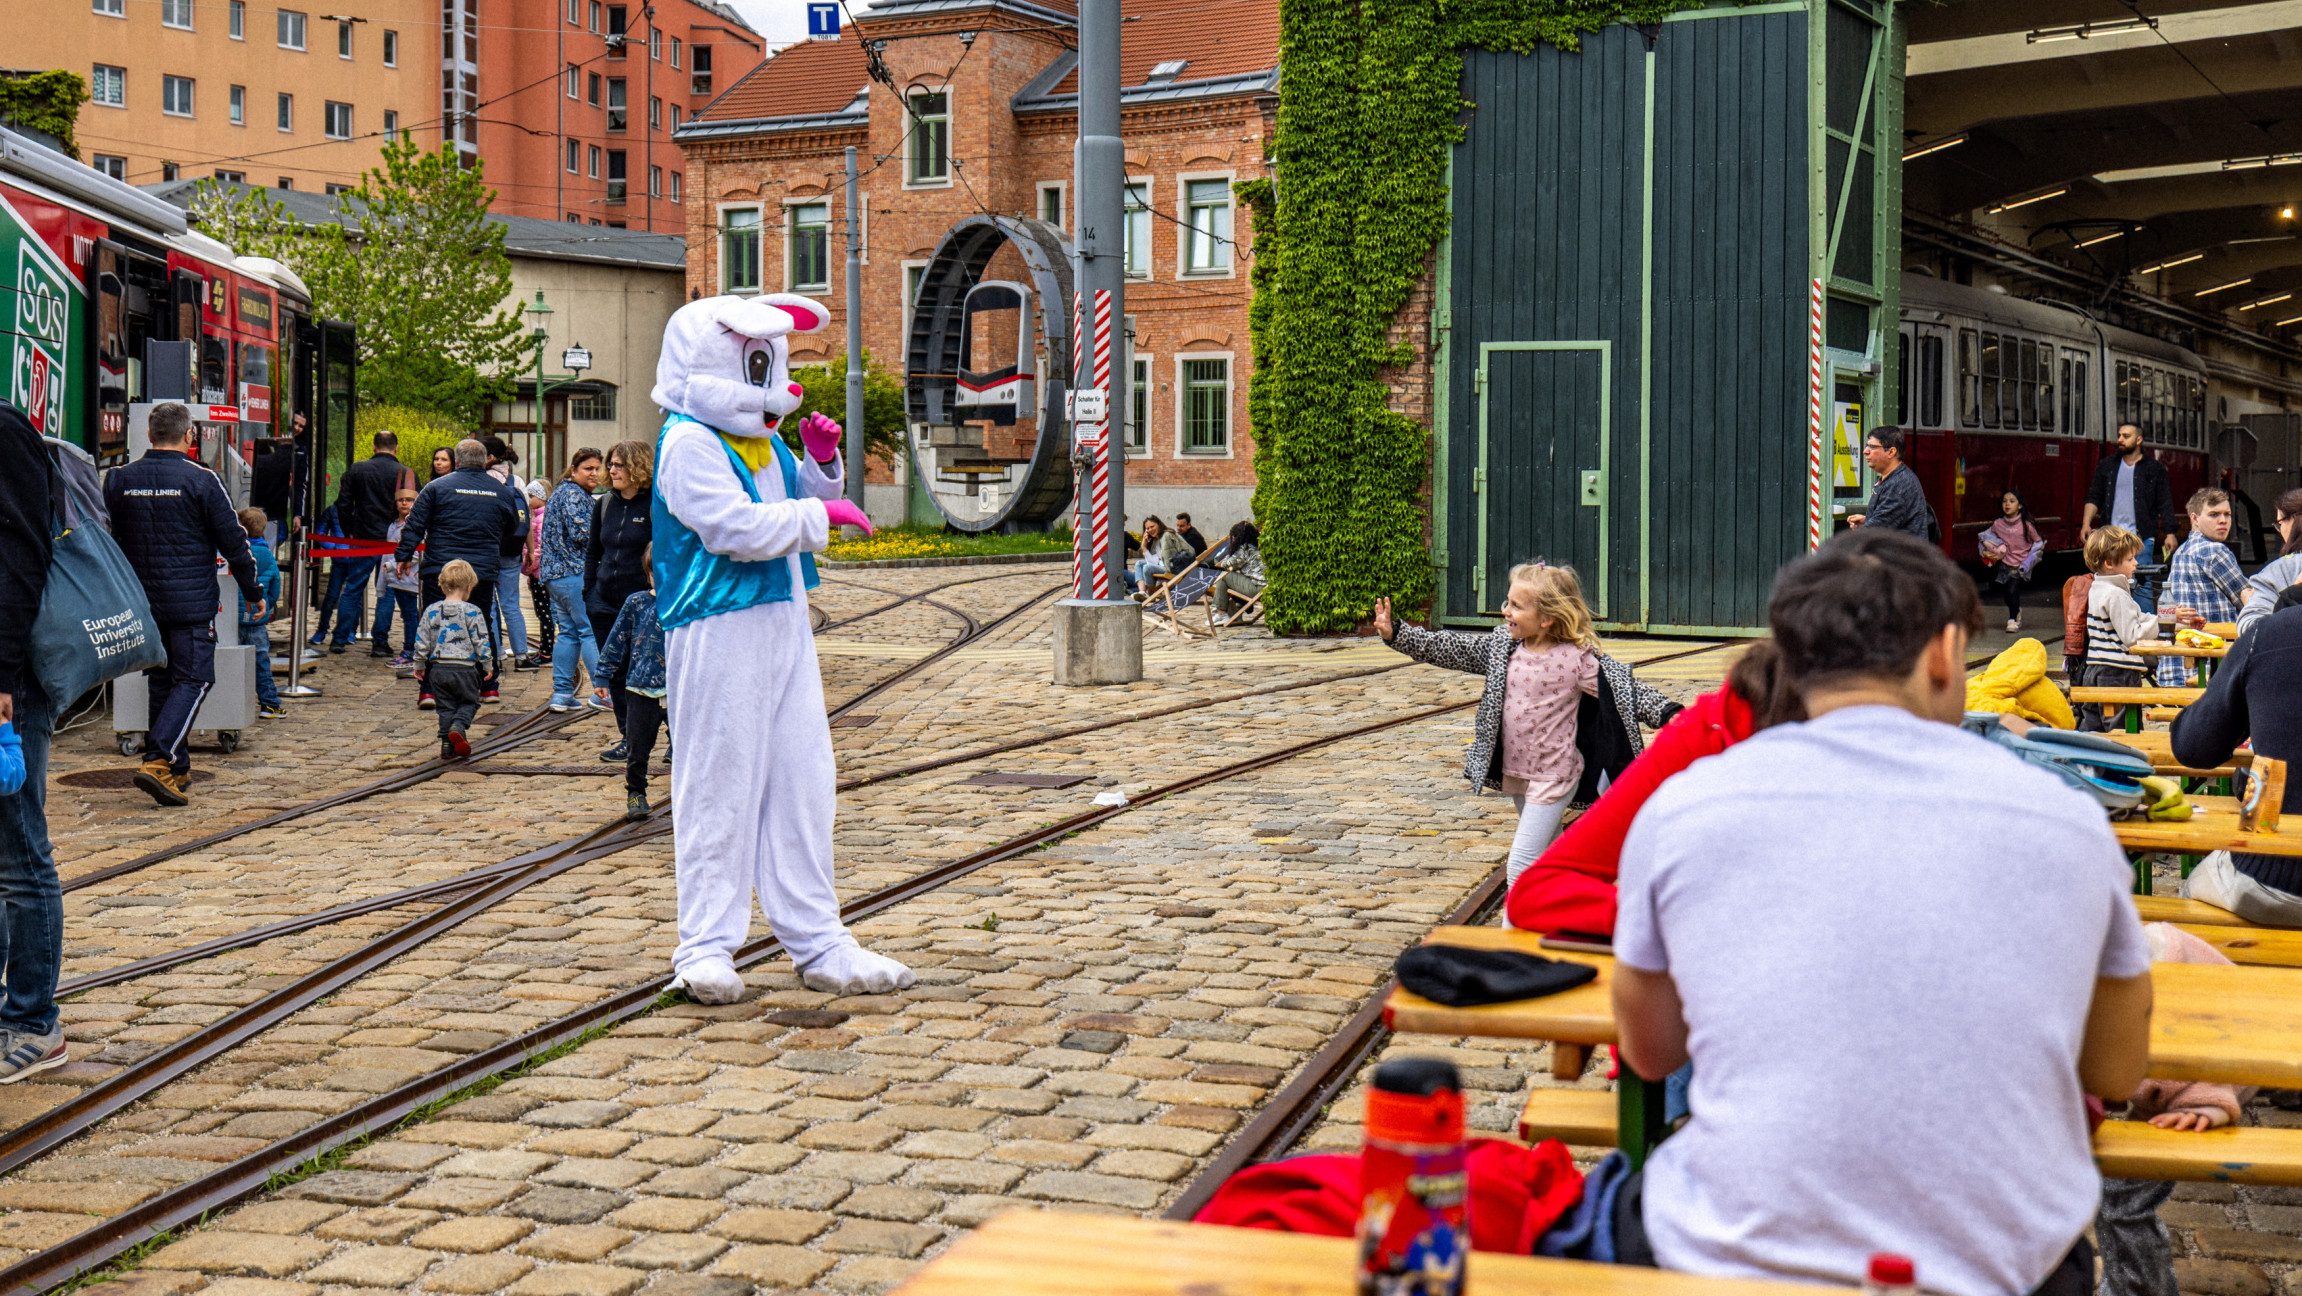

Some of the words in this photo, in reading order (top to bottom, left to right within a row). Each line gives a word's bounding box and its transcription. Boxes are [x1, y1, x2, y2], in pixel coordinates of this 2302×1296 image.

[812, 6, 834, 31] T
[1084, 226, 1096, 241] 14
[22, 266, 64, 351] SOS
[479, 489, 497, 497] LINIEN
[82, 608, 135, 632] European
[89, 618, 143, 645] University
[95, 634, 146, 659] Institute
